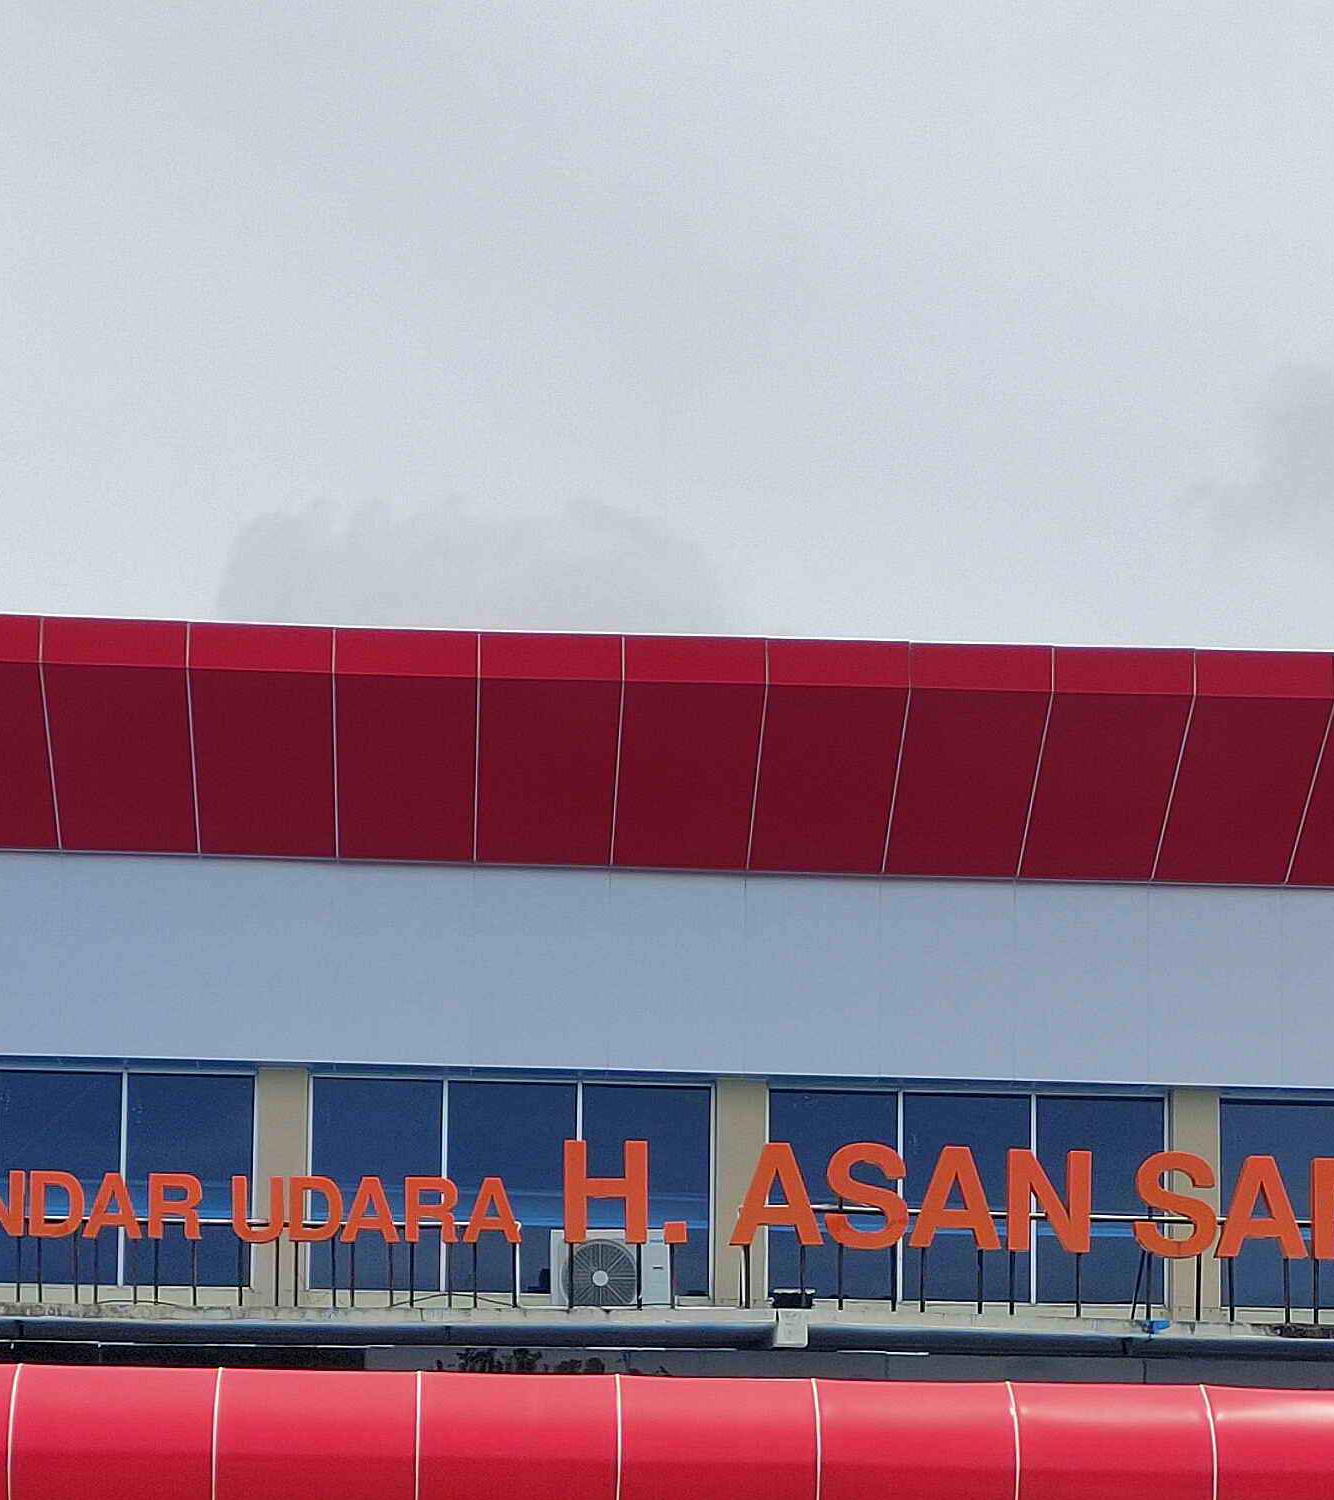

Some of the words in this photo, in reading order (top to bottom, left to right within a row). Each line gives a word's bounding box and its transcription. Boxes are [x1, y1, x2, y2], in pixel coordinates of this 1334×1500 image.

[231, 1176, 522, 1243] UDARA
[563, 1139, 687, 1244] H.
[729, 1142, 1092, 1253] ASAN
